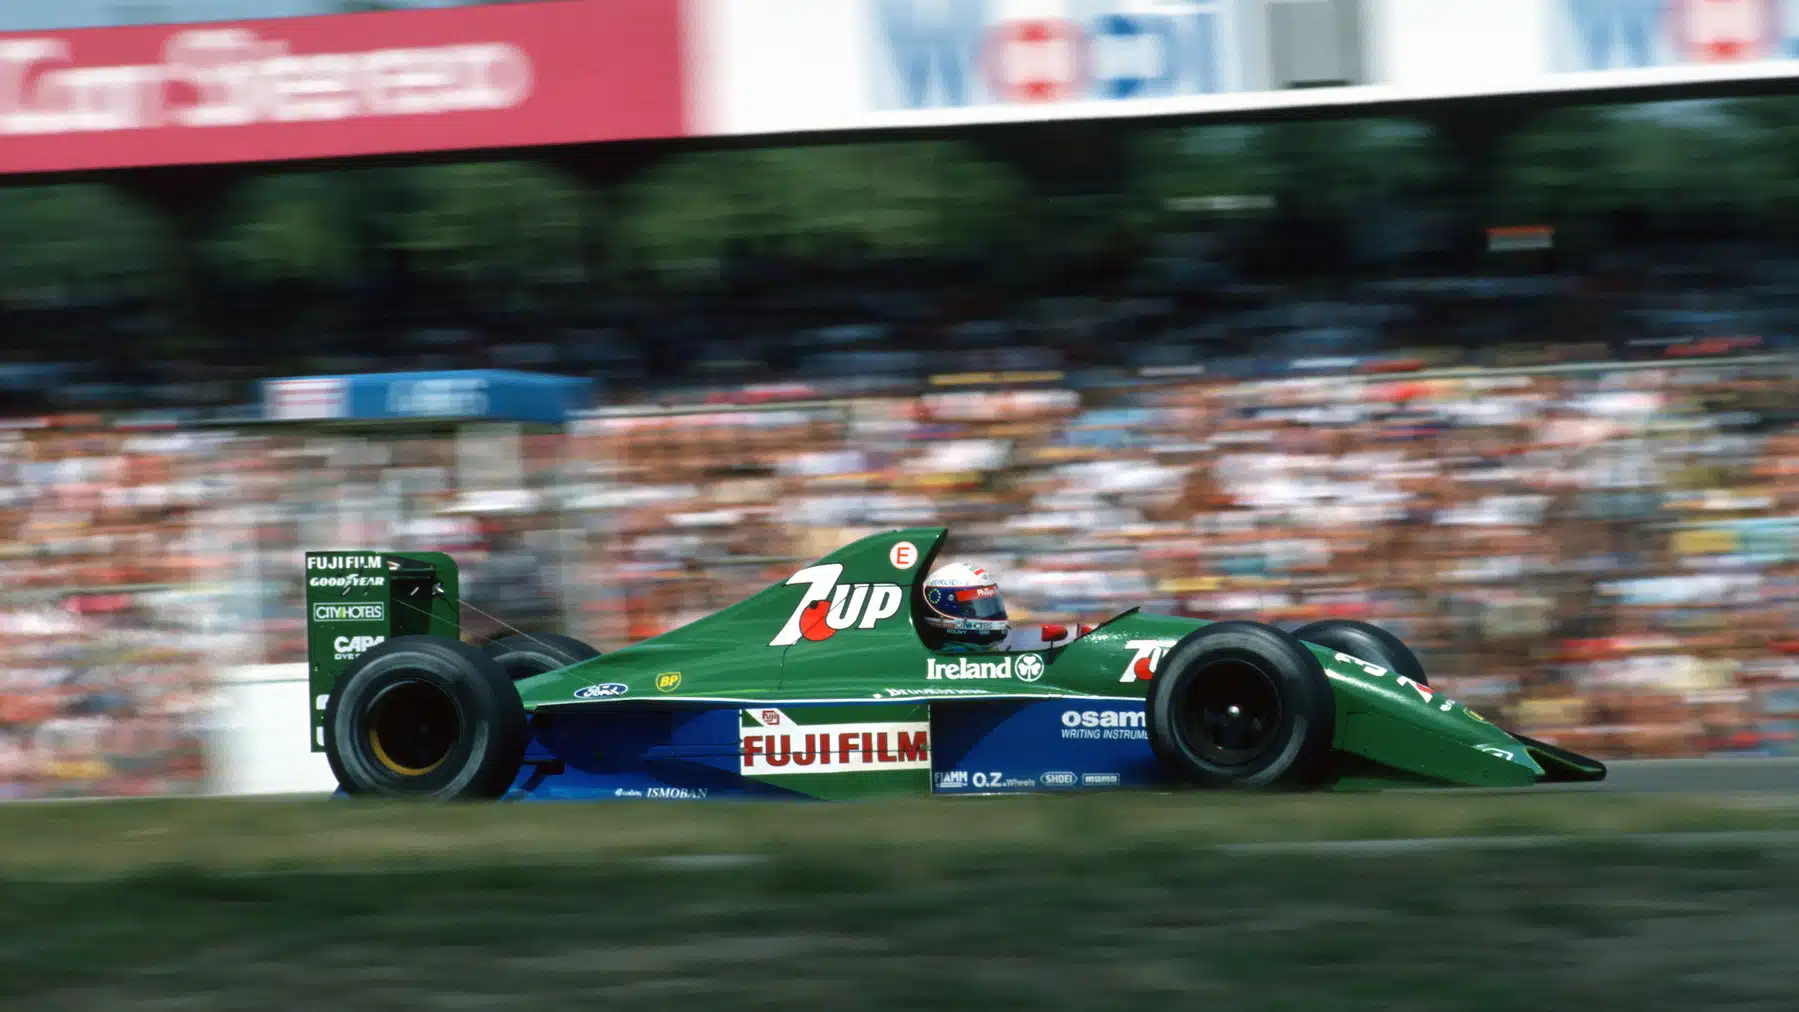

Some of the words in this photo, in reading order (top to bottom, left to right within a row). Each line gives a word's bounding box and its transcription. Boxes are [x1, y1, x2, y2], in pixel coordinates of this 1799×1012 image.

[307, 556, 381, 569] FUJIFILM
[896, 547, 909, 565] E
[310, 573, 385, 588] GOODYEAR
[768, 563, 903, 647] 7UP
[926, 656, 1012, 680] Ireland
[660, 675, 679, 687] BP
[583, 684, 620, 697] Ford
[1061, 729, 1101, 739] WRITING
[934, 771, 969, 783] FIAMM
[1045, 774, 1073, 784] SHOEI
